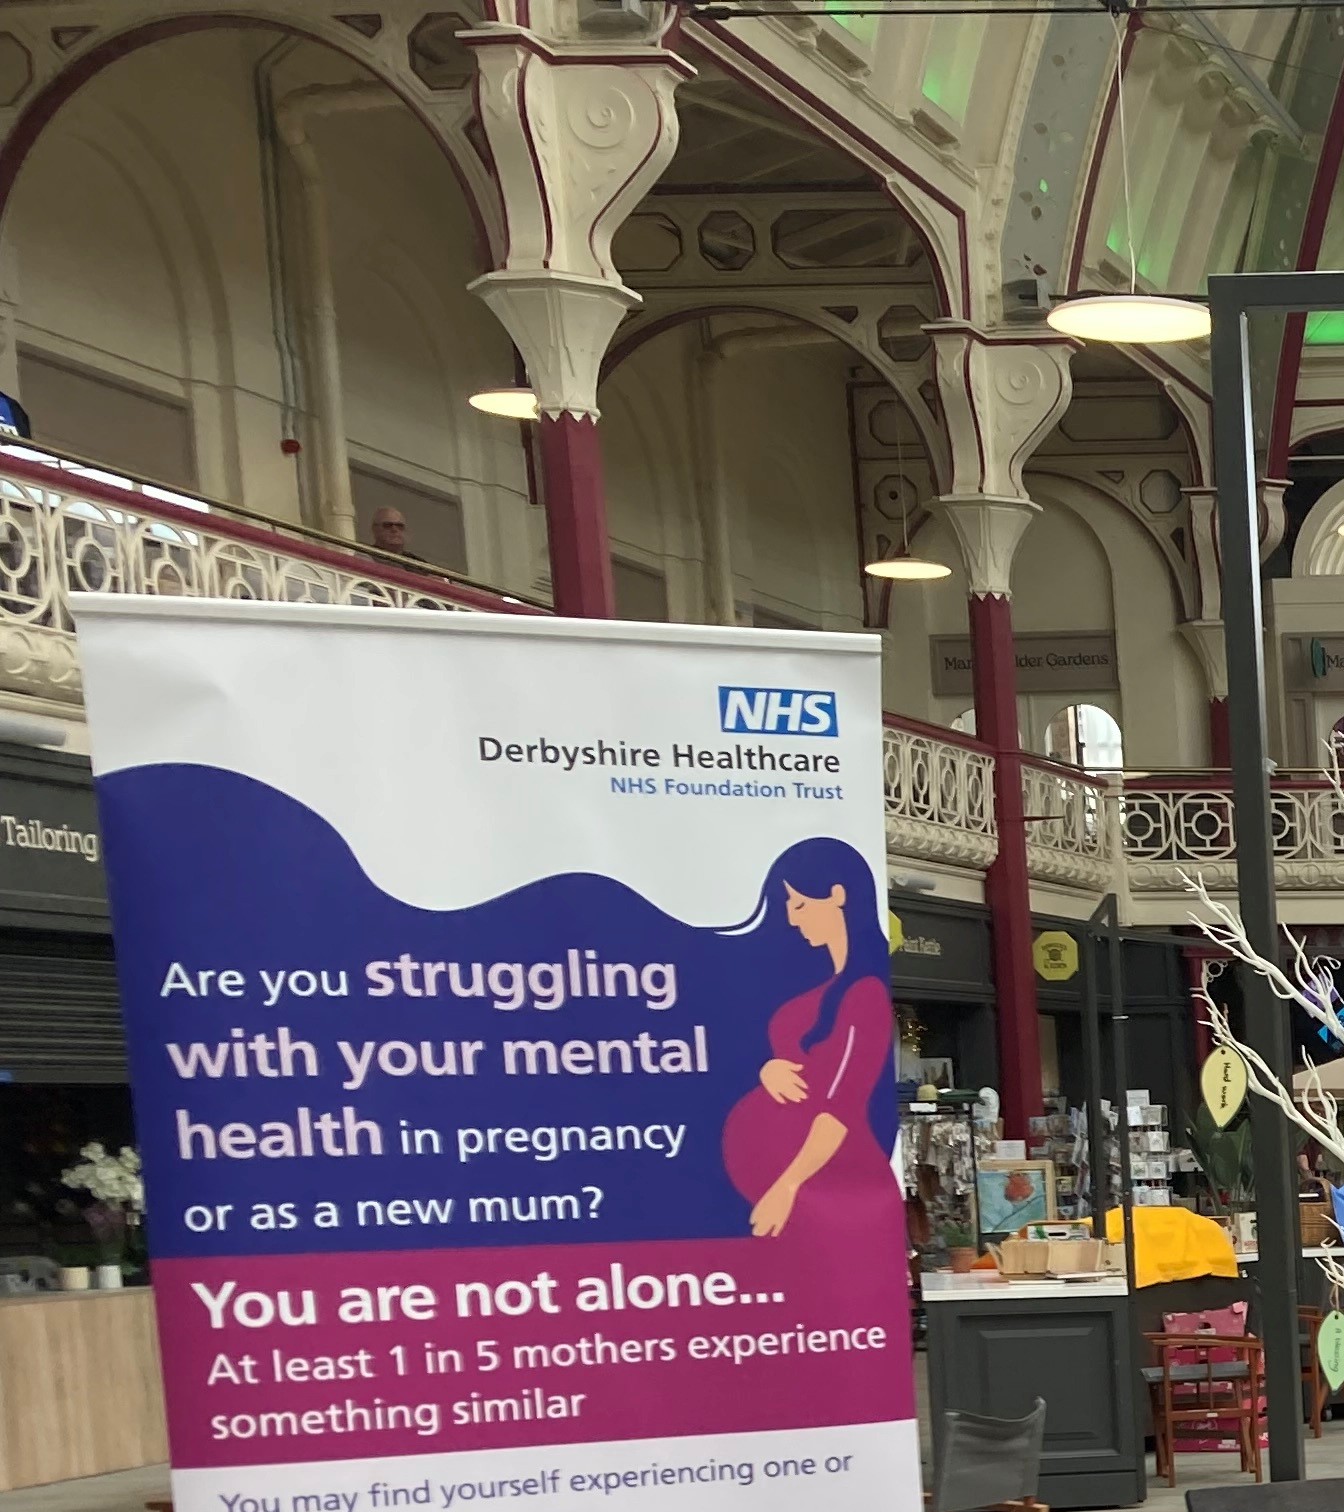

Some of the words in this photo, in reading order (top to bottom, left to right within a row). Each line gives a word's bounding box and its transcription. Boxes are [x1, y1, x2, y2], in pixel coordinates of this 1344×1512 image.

[1045, 653, 1109, 668] Gardens
[724, 689, 832, 734] NHS
[478, 736, 661, 772] Derbyshire
[672, 743, 840, 773] Healthcare
[610, 777, 657, 795] NHS
[664, 778, 786, 798] Foundation
[791, 782, 844, 801] Trust
[0, 812, 98, 863] Tailoring
[160, 962, 246, 997] Are
[258, 969, 349, 1007] you
[365, 948, 677, 1011] struggling
[166, 1026, 319, 1079] with
[336, 1040, 484, 1091] your
[502, 1025, 709, 1075] mental
[175, 1105, 383, 1160] health
[399, 1119, 441, 1155] in
[457, 1124, 686, 1163] pregnancy
[184, 1204, 234, 1232] or
[250, 1202, 298, 1230] as
[313, 1201, 340, 1228] a
[356, 1198, 453, 1227] new
[468, 1185, 604, 1223] mum?
[190, 1281, 317, 1329] You
[338, 1284, 437, 1324] are
[455, 1271, 561, 1318] not
[575, 1264, 785, 1312] alone...
[207, 1353, 259, 1386] At
[272, 1348, 376, 1383] least
[389, 1345, 405, 1376] 1
[424, 1342, 463, 1374] in
[476, 1339, 500, 1372] 5
[513, 1332, 677, 1369] mothers
[687, 1323, 887, 1365] experience
[211, 1397, 440, 1440] something
[452, 1388, 587, 1425] similar
